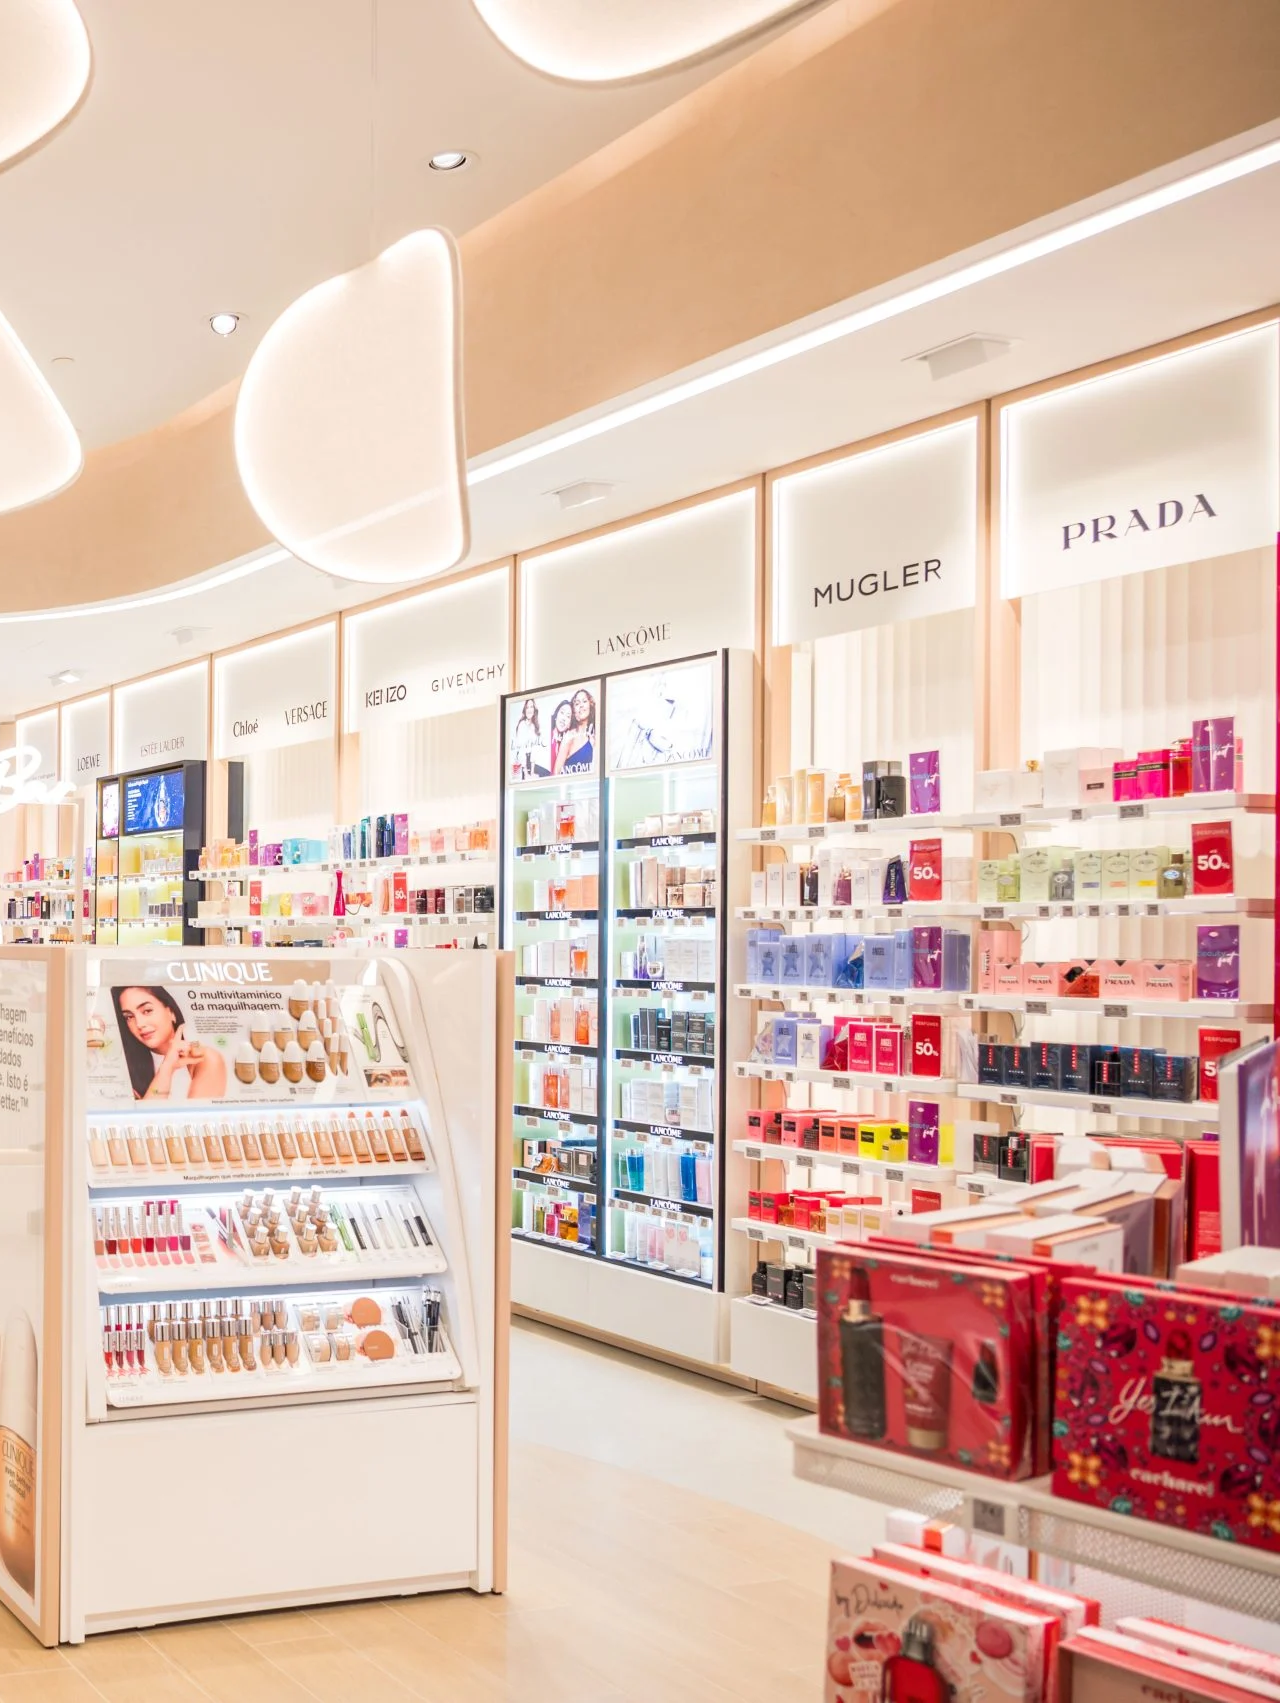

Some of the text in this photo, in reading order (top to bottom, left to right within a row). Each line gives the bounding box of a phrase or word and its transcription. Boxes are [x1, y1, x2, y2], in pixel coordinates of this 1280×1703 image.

[1061, 492, 1218, 551] PRADA
[814, 558, 942, 607] MUGLER
[596, 623, 671, 656] LANCÔME
[621, 647, 645, 657] PARIS
[431, 663, 505, 692] GIVENCHY
[365, 684, 407, 708] KENZO
[284, 700, 328, 727] VERSACE
[232, 719, 259, 738] Chloé
[159, 736, 185, 753] LAUDER
[77, 753, 101, 772] LOEWE
[558, 761, 593, 775] ANCÔME
[652, 836, 683, 846] LANCÔME
[545, 844, 572, 853] LANCÔME
[1197, 854, 1230, 871] 50%
[913, 867, 939, 880] 50%
[545, 910, 572, 919] LANCÔME
[652, 909, 684, 918] LANCÔME
[166, 962, 273, 985] CLINIQUE
[544, 978, 572, 987] LANCÔME
[651, 981, 683, 990] LANCÔME
[187, 990, 197, 999] O
[190, 1002, 284, 1012] da maquilhagem.
[544, 1044, 571, 1054] LANCÔME
[915, 1041, 939, 1056] 50%
[651, 1053, 682, 1064] LANCÔME
[6, 1072, 22, 1090] Isto
[23, 1074, 29, 1092] é
[543, 1110, 570, 1121] LANCÔME
[650, 1126, 682, 1137] LANCÔME
[543, 1177, 569, 1188] LANCÔME
[650, 1199, 682, 1212] LANCÔME
[1107, 1376, 1156, 1425] Yes
[1129, 1467, 1214, 1498] cacharel
